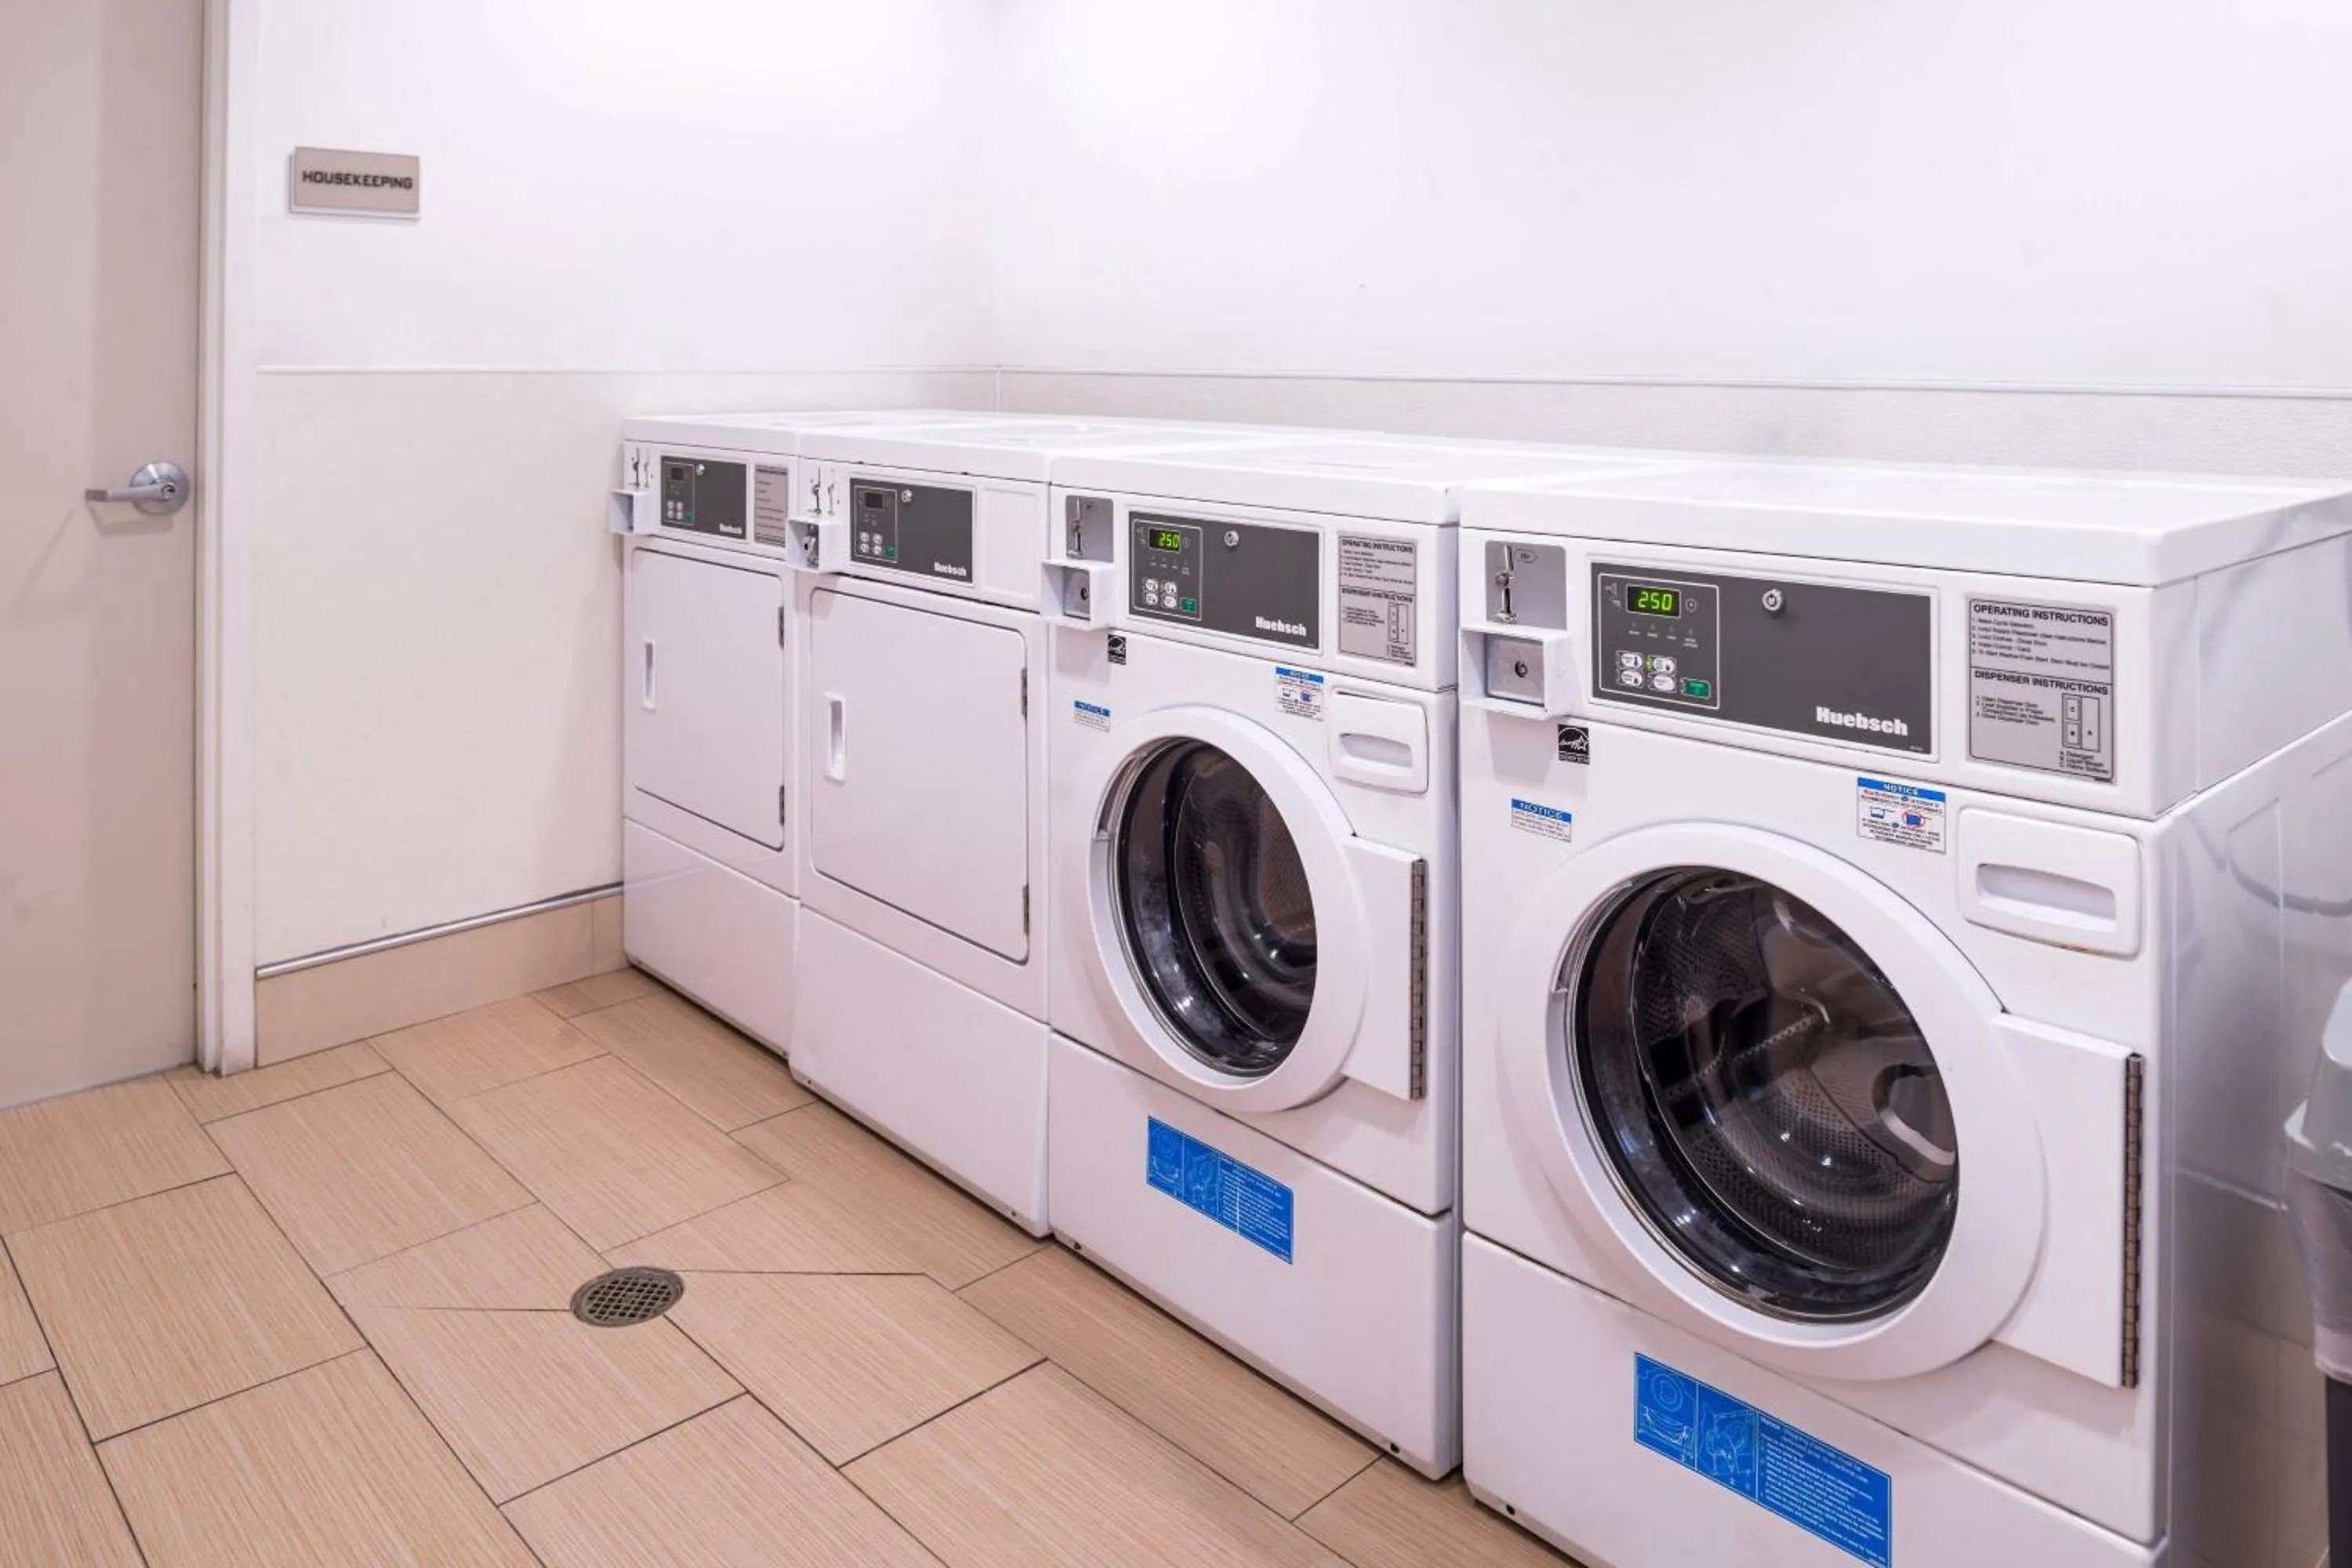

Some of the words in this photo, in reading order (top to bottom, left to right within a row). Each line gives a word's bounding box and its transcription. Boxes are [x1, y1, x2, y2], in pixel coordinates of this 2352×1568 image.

[302, 170, 413, 189] HOUSEKEEPING
[1159, 532, 1179, 548] 250
[1638, 591, 1672, 611] 250
[1973, 604, 2030, 619] OPERATING
[2032, 609, 2108, 626] INSTRUCTIONS
[1255, 615, 1307, 637] Huebsch
[1974, 670, 2030, 684] DISPENSER
[2031, 675, 2108, 695] INSTRUCTIONS
[1816, 706, 1907, 736] Huebsch
[1883, 783, 1918, 796] NOTICE
[1519, 801, 1563, 819] NOTICE
